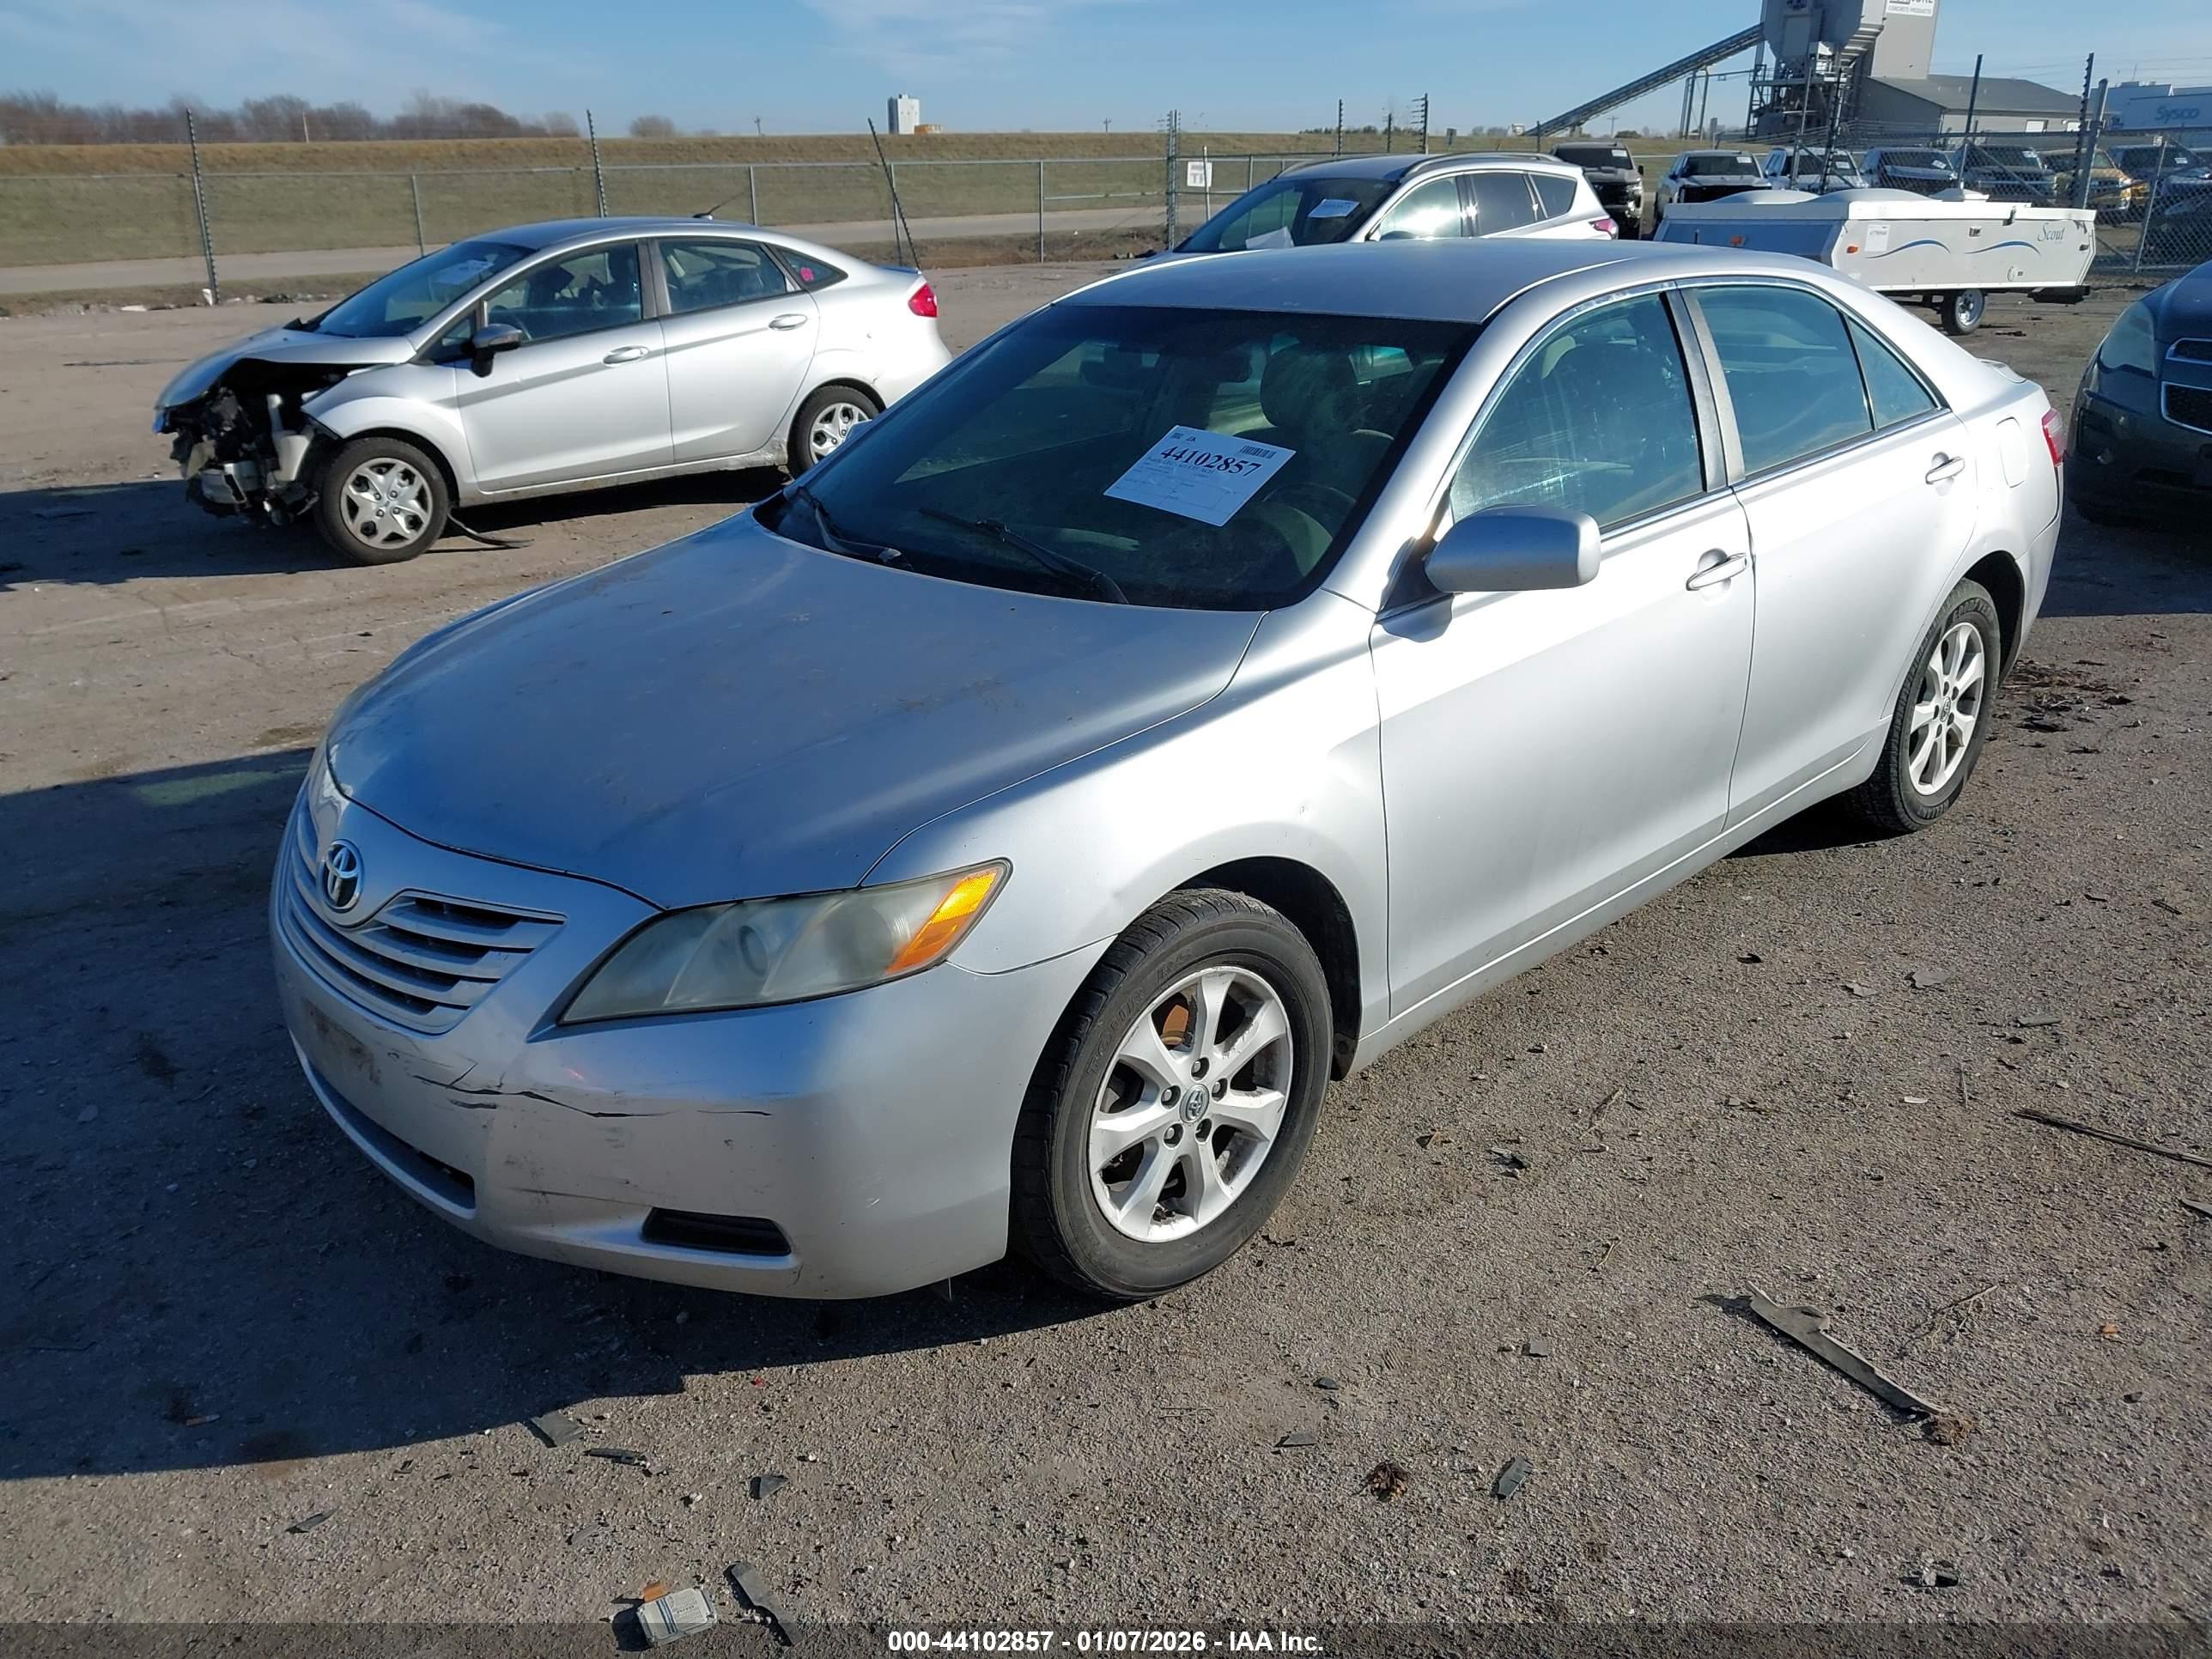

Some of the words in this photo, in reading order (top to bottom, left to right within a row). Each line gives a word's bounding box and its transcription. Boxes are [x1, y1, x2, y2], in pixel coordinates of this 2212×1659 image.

[2155, 106, 2200, 124] Sysco
[2038, 222, 2066, 241] Scout
[1160, 446, 1261, 477] 44102857
